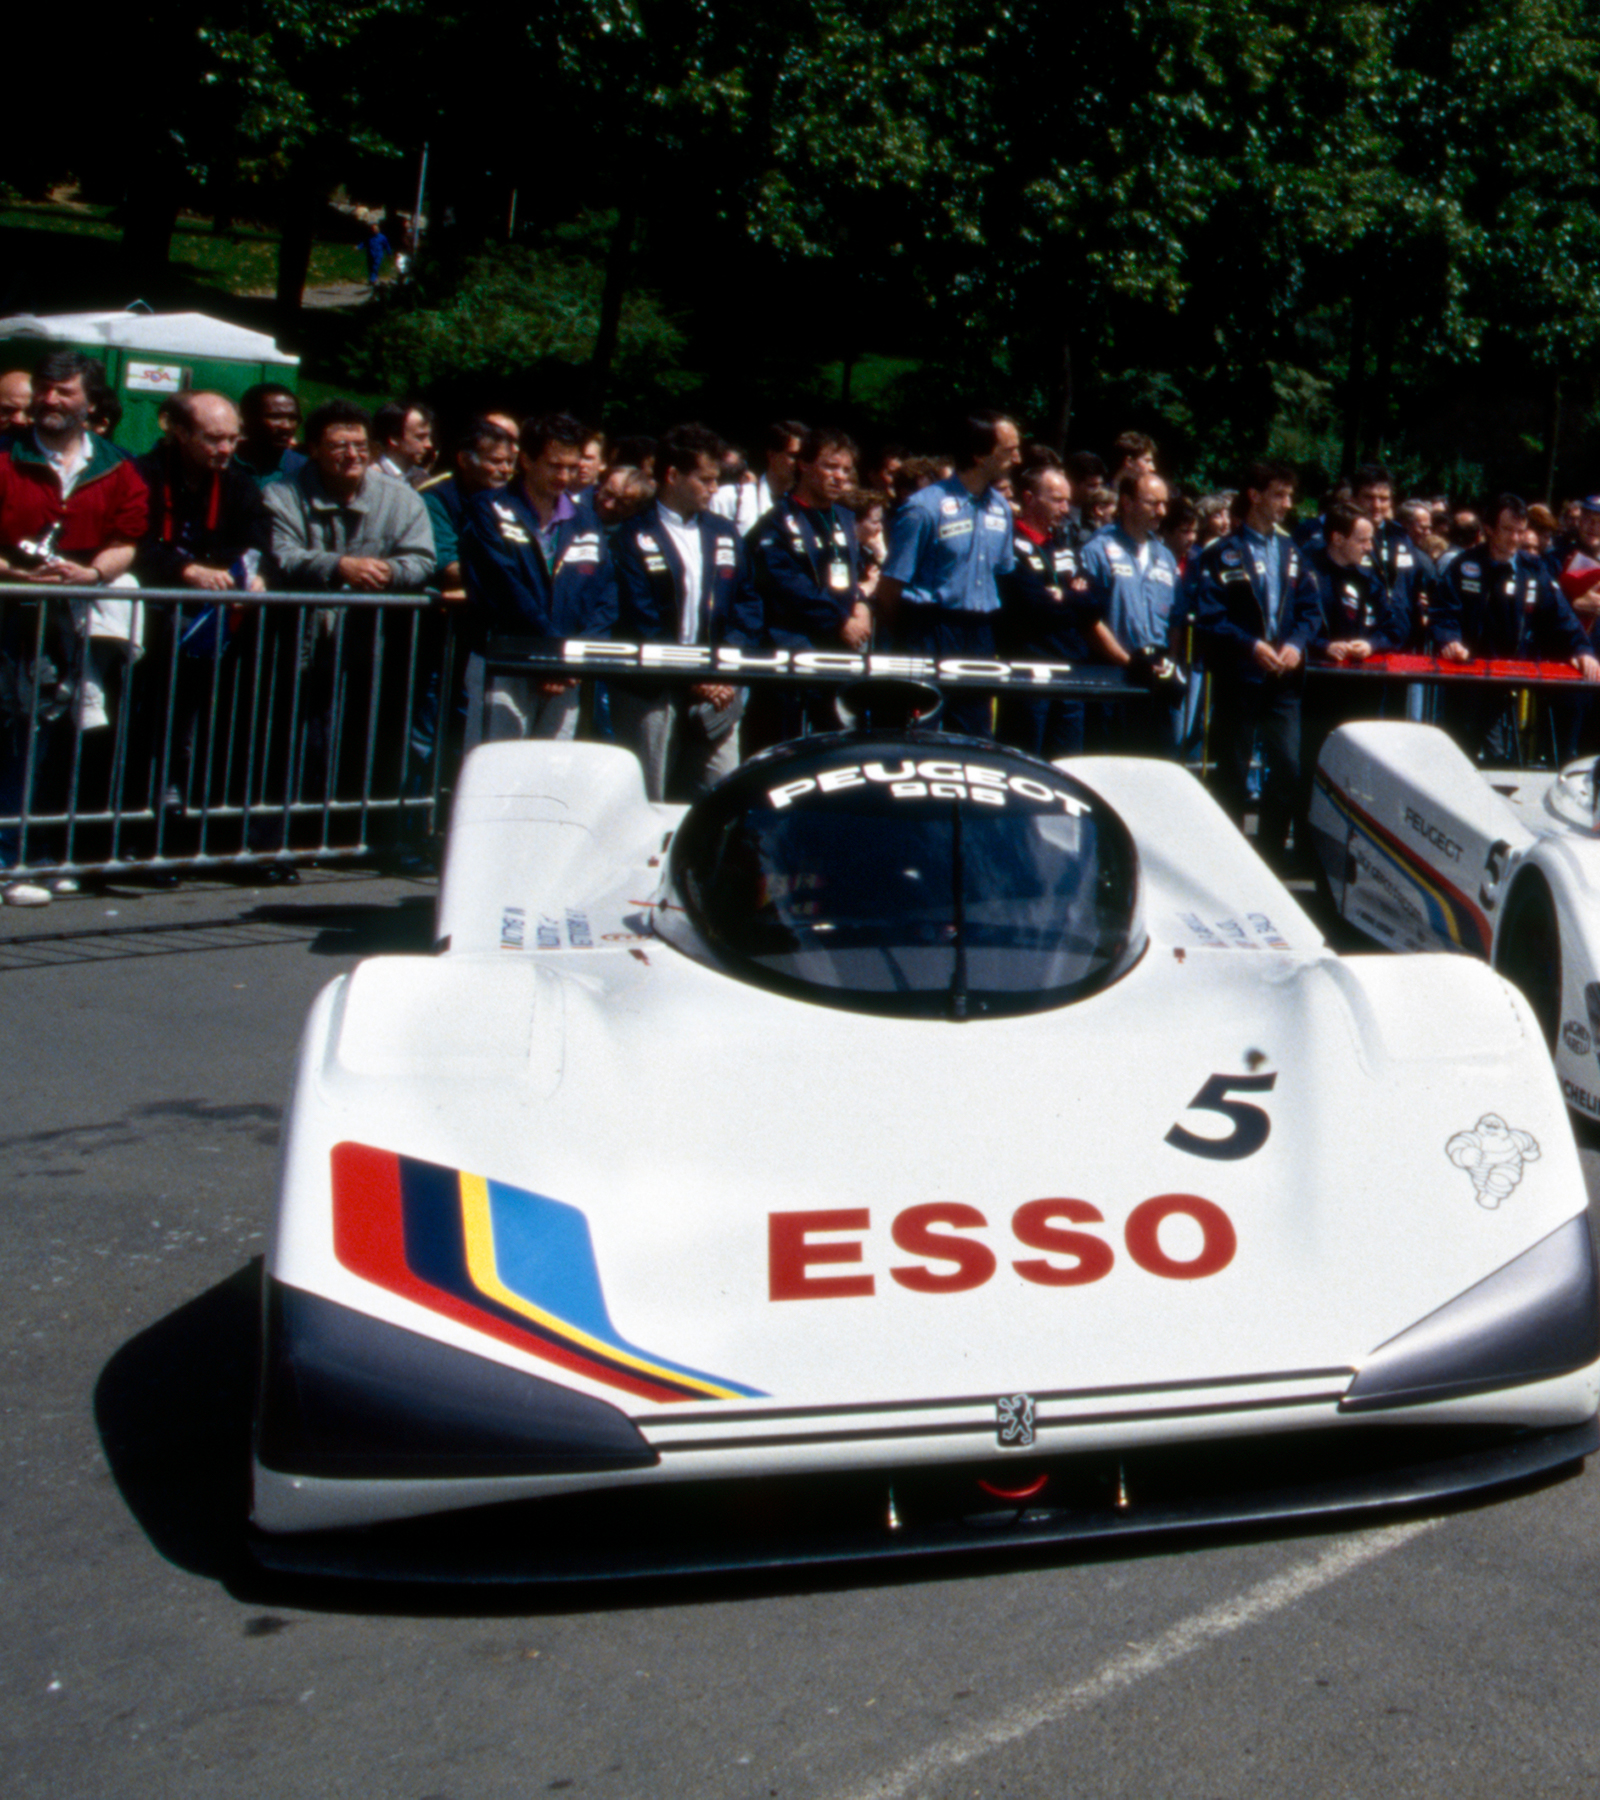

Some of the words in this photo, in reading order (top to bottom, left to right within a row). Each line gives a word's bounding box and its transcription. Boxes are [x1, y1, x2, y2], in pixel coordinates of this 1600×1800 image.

[563, 640, 1072, 683] PEUGEOT
[768, 761, 1092, 818] PEUGEOT
[1163, 1071, 1278, 1161] 5
[768, 1193, 1237, 1301] ESSO
